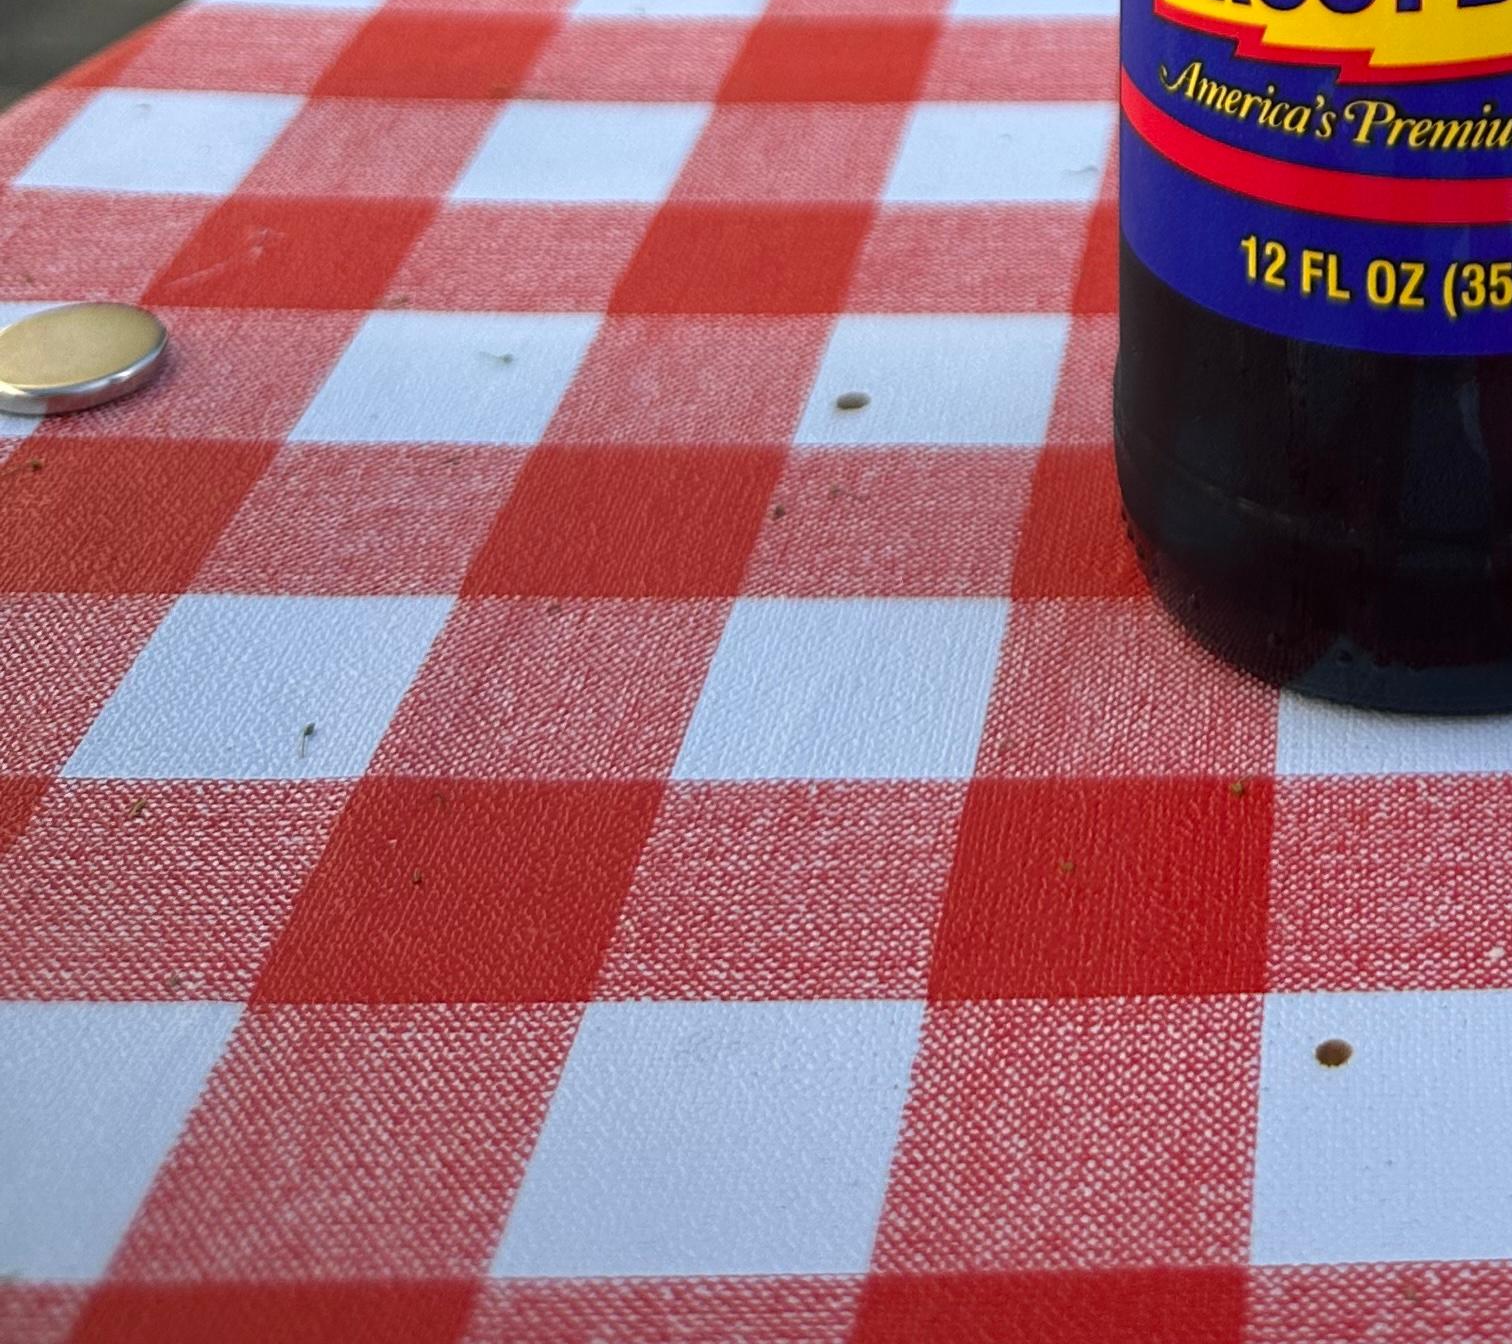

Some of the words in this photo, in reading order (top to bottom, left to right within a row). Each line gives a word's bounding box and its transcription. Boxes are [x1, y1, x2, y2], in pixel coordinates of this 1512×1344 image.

[1159, 61, 1338, 140] America's
[1241, 235, 1287, 287] 12
[1301, 249, 1350, 300] FL
[1366, 258, 1426, 307] OZ
